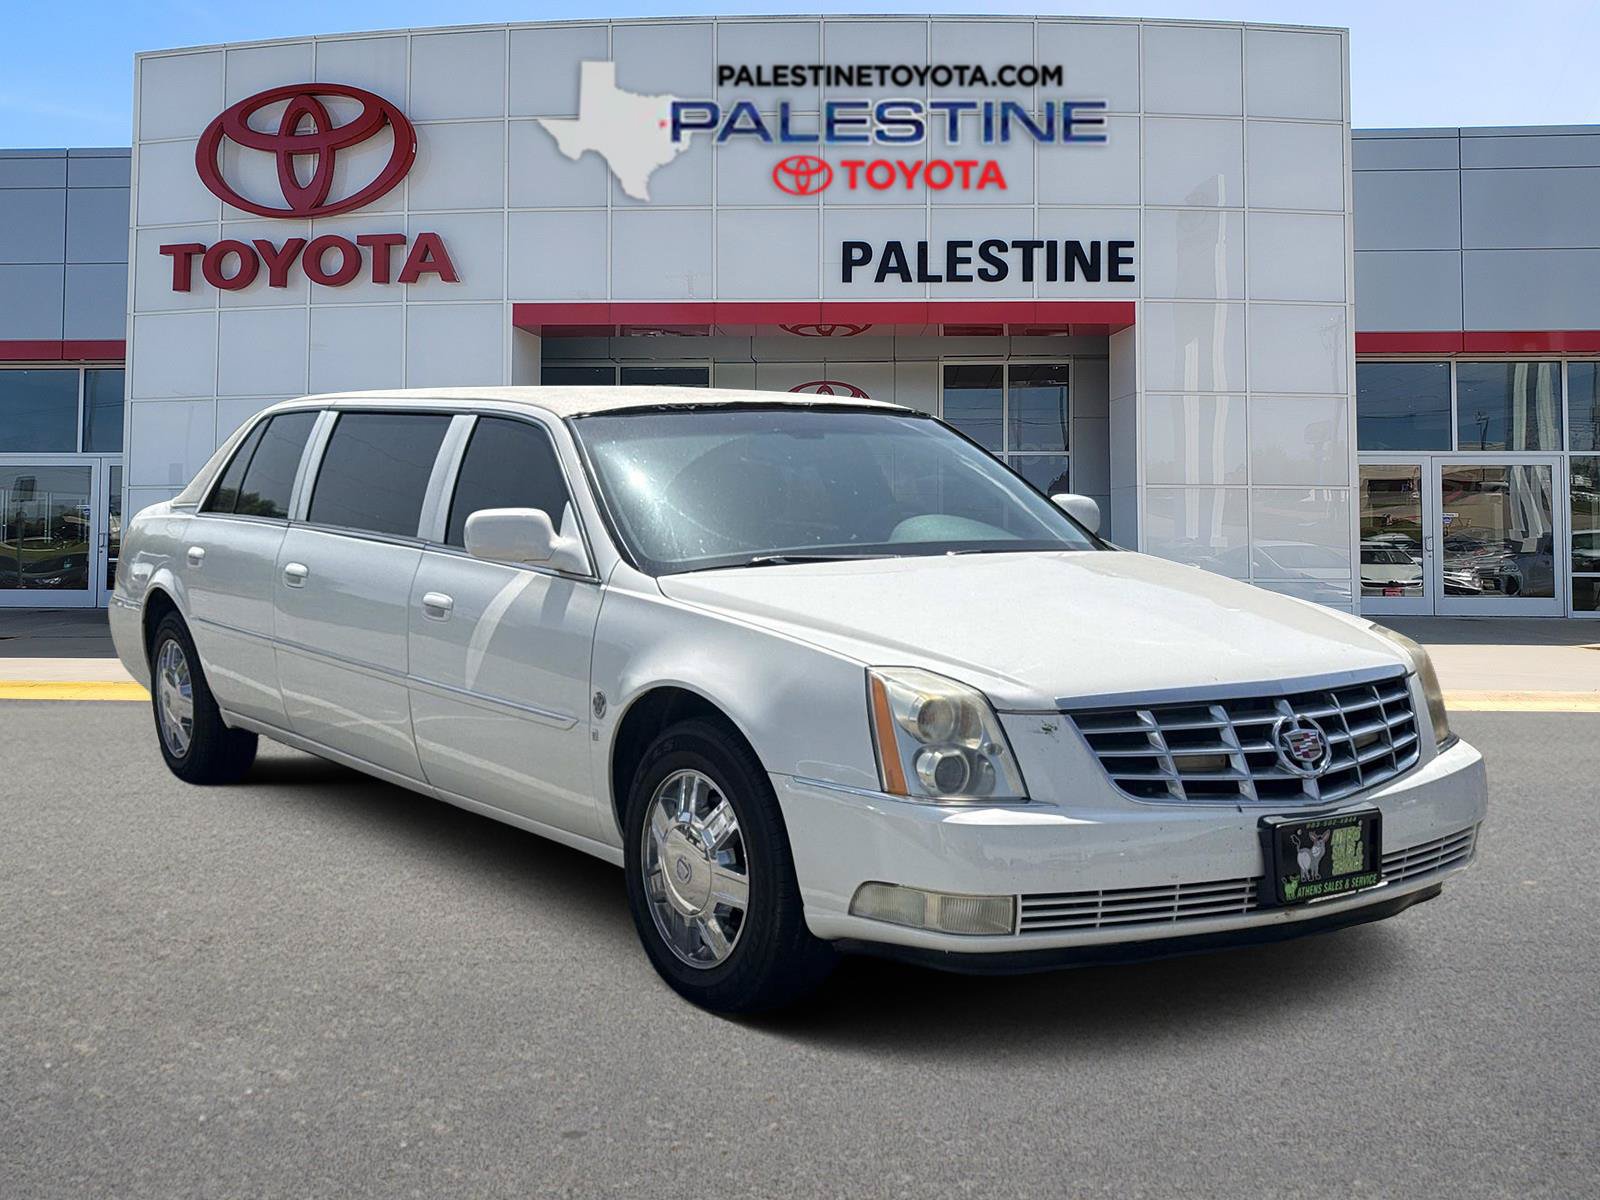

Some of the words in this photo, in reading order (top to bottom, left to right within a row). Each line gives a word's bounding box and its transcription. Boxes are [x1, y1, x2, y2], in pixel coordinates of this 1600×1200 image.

[159, 232, 460, 292] TOYOTA
[841, 240, 1135, 283] PALESTINE
[1297, 883, 1323, 898] ATHENS
[1323, 879, 1344, 893] SALES
[1344, 878, 1351, 889] &
[1351, 873, 1378, 888] SERVICE
